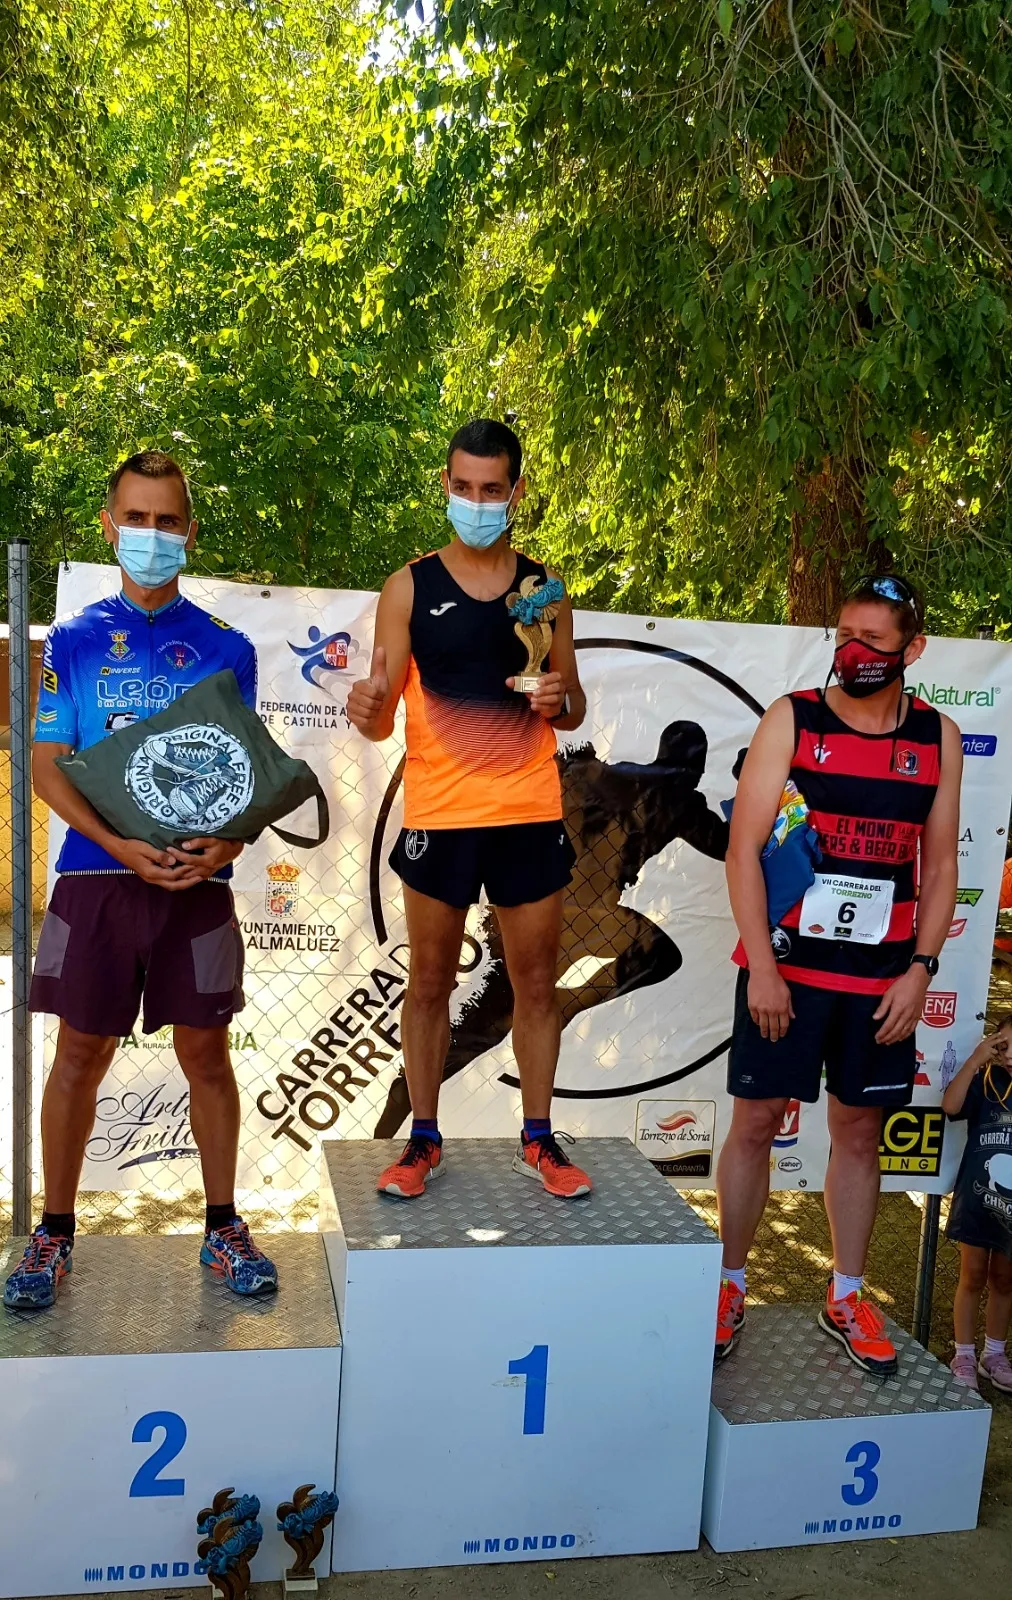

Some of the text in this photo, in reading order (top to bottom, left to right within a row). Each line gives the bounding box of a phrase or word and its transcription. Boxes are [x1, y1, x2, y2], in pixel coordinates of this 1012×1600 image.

[260, 701, 321, 715] FEDERACIÓN
[324, 705, 337, 716] DE
[260, 714, 353, 730] DE CASTILLA Y
[158, 730, 239, 755] ORIGINAL
[227, 761, 247, 806] FREE
[836, 817, 851, 835] EL
[854, 819, 895, 840] MONO
[849, 837, 861, 855] &
[864, 838, 897, 858] BEER
[831, 887, 873, 900] TORREZNO
[832, 879, 869, 892] CARRERA
[869, 884, 882, 892] DEL
[837, 901, 858, 924] 6
[246, 935, 341, 953] ALMALUEZ
[142, 1042, 166, 1050] RURAL
[256, 968, 405, 1121] CARRERA
[677, 1128, 687, 1141] de
[687, 1128, 711, 1142] Soria
[878, 1111, 943, 1154] GE
[980, 1132, 1010, 1147] CARRERA
[507, 1344, 549, 1436] 1
[129, 1411, 188, 1498] 2
[840, 1440, 881, 1506] 3
[822, 1514, 902, 1535] MONDO
[484, 1533, 577, 1554] MONDO
